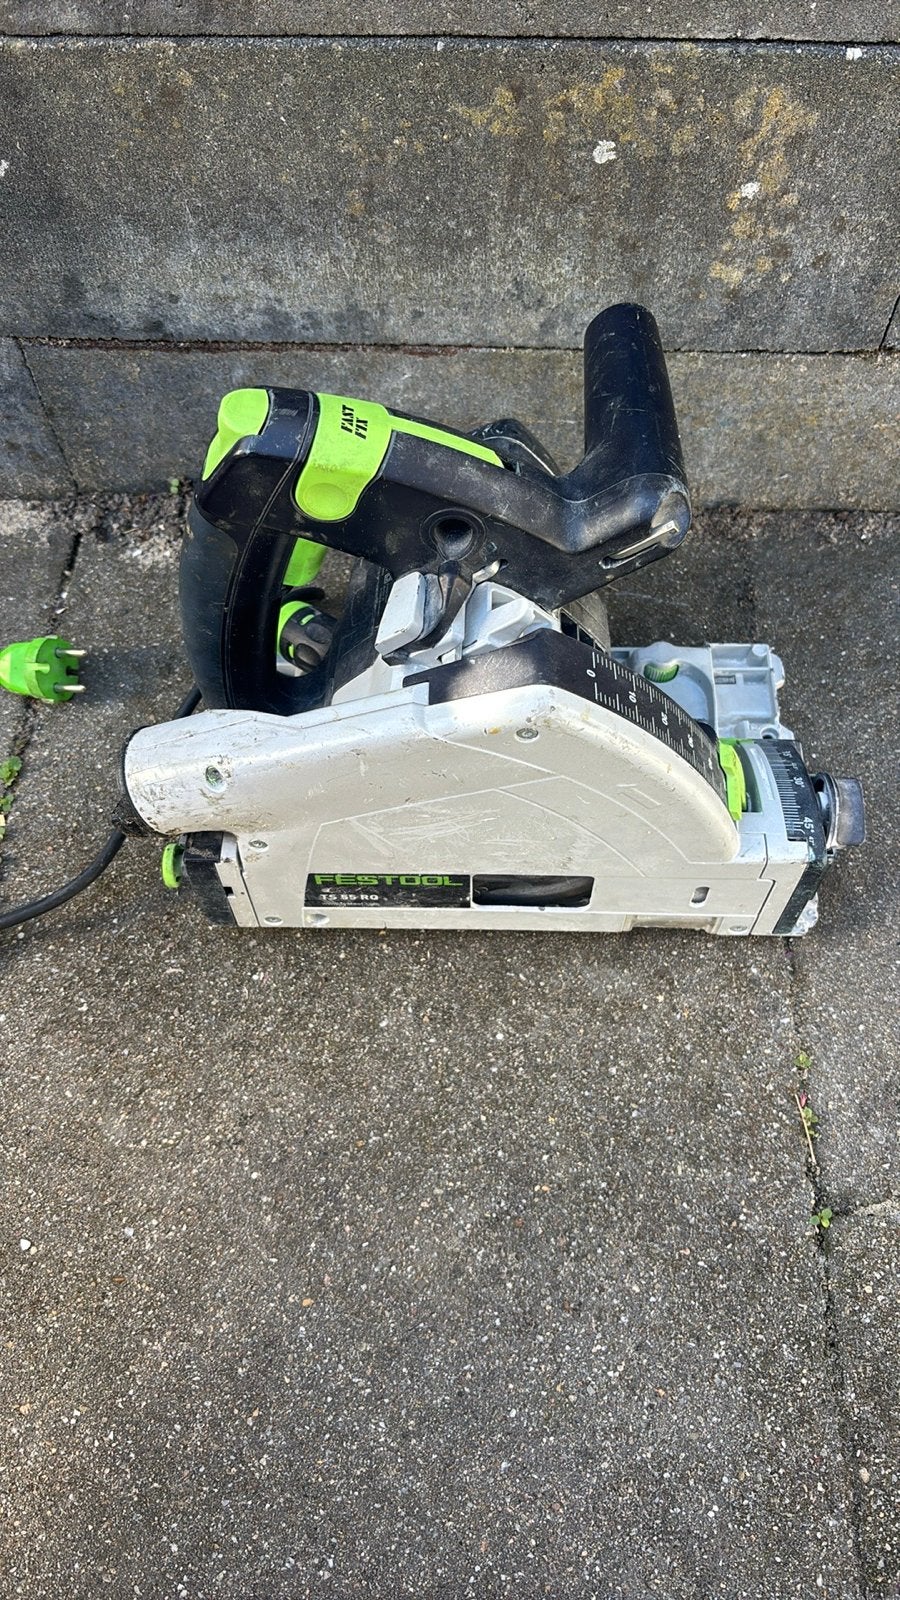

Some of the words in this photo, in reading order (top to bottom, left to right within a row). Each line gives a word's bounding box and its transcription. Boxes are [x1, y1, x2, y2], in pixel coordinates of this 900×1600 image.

[341, 404, 354, 433] FAST
[355, 417, 368, 440] FIX
[586, 669, 596, 678] 0
[628, 691, 637, 703] 10
[314, 874, 464, 886] FESTOOL
